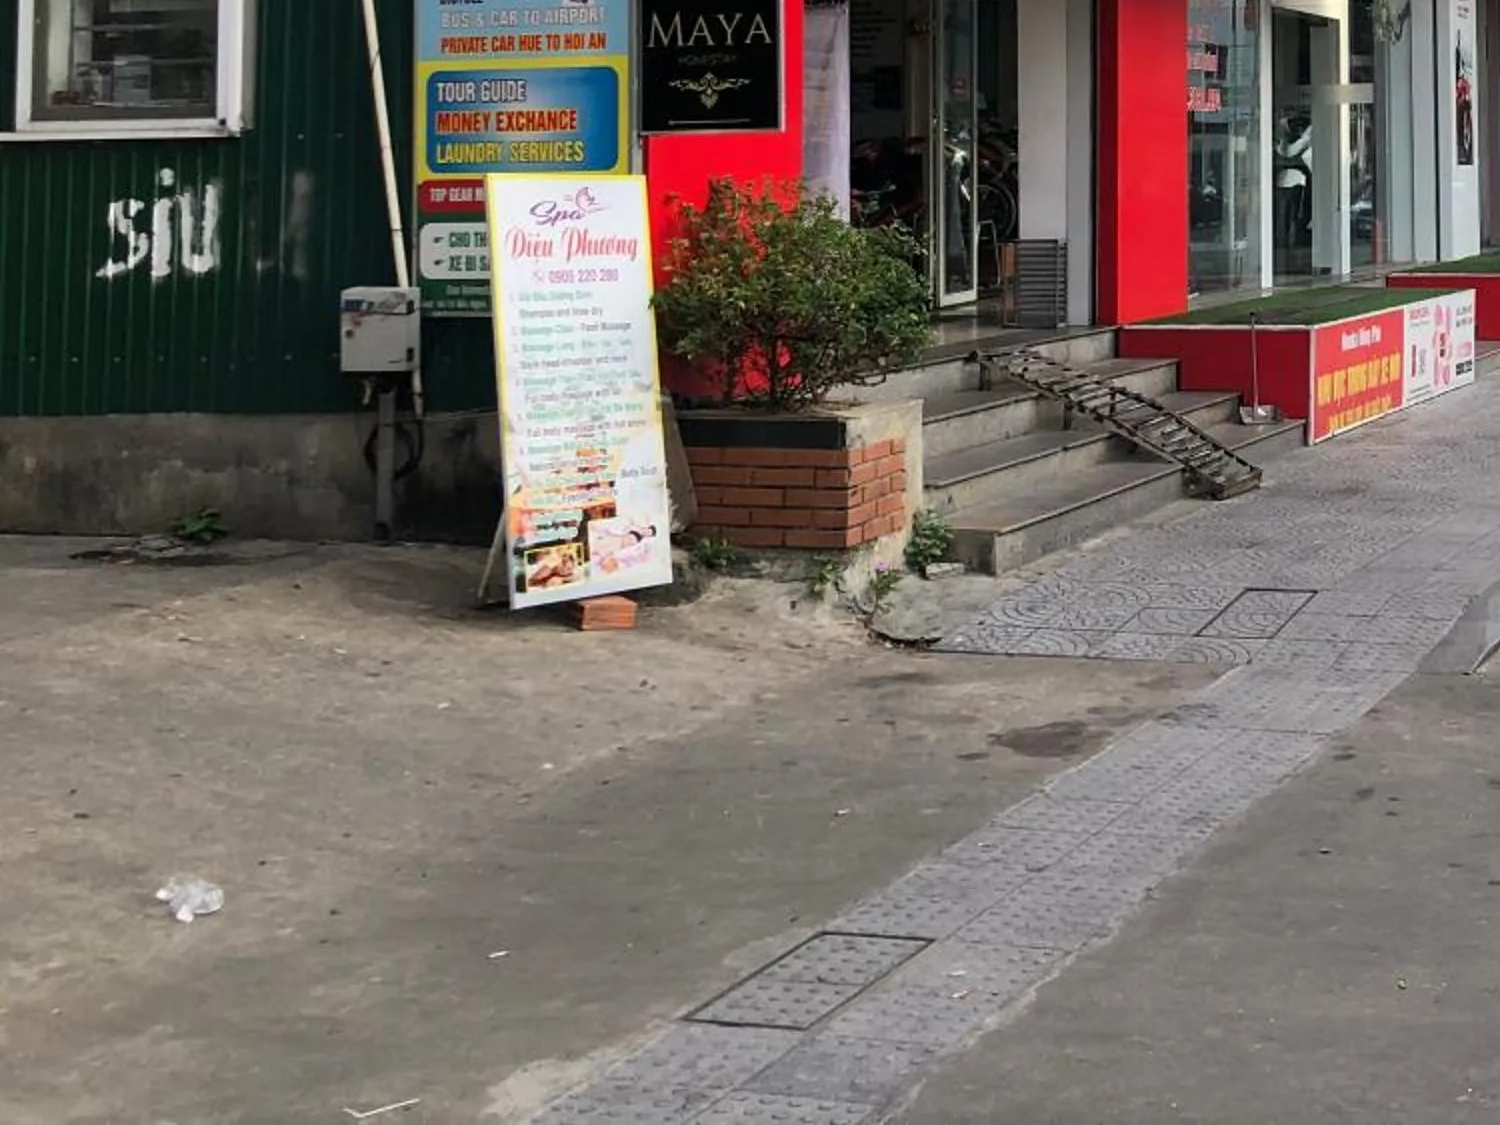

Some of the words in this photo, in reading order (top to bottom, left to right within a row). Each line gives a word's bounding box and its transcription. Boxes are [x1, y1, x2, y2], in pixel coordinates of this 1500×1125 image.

[441, 11, 469, 27] BUS
[490, 10, 518, 26] CAR
[524, 10, 540, 25] TO
[544, 7, 605, 25] AIRPORT
[647, 11, 773, 48] MAYA
[441, 37, 488, 53] PRIVATE
[491, 35, 515, 51] CAR
[520, 34, 542, 51] HUE
[546, 34, 560, 50] TO
[563, 33, 585, 49] HOI
[588, 32, 607, 49] AN
[436, 82, 476, 102] TOUR
[480, 80, 527, 101] GUIDE
[436, 111, 491, 132] MONEY
[437, 141, 502, 163] LAUNDRY
[510, 139, 584, 162] SERVICES
[530, 199, 585, 227] Spa
